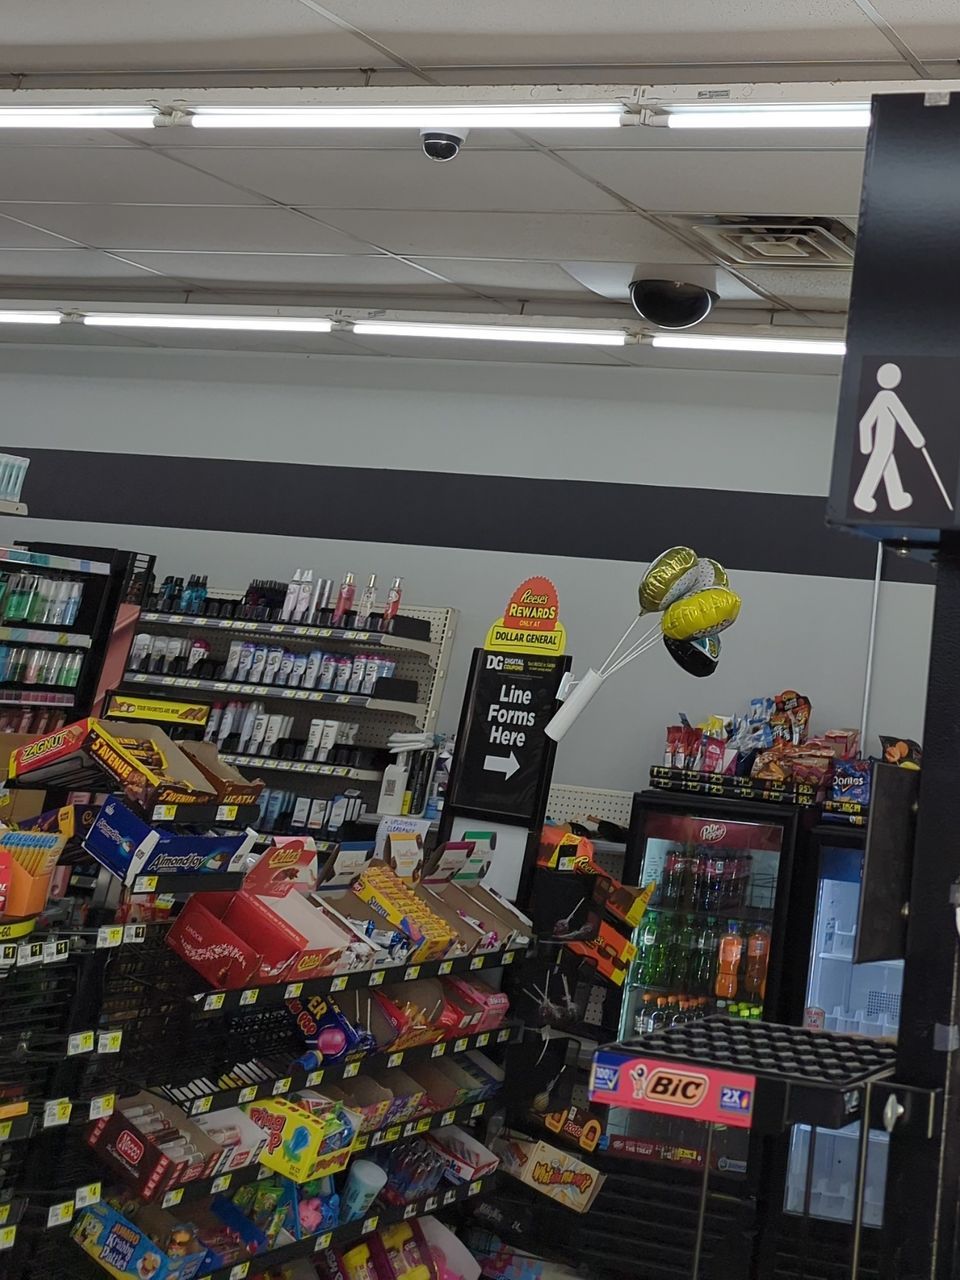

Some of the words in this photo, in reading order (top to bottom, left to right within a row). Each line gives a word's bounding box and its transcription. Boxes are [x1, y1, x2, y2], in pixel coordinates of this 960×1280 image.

[509, 603, 556, 618] REWARDS
[495, 631, 524, 642] DOLLAR
[526, 634, 557, 645] GENERAL
[486, 655, 504, 670] DG
[500, 684, 532, 705] Line
[487, 704, 536, 726] Forms
[489, 725, 526, 747] Here
[21, 731, 68, 761] ZAGNUT
[149, 852, 192, 870] Almond
[722, 1088, 741, 1103] 2X
